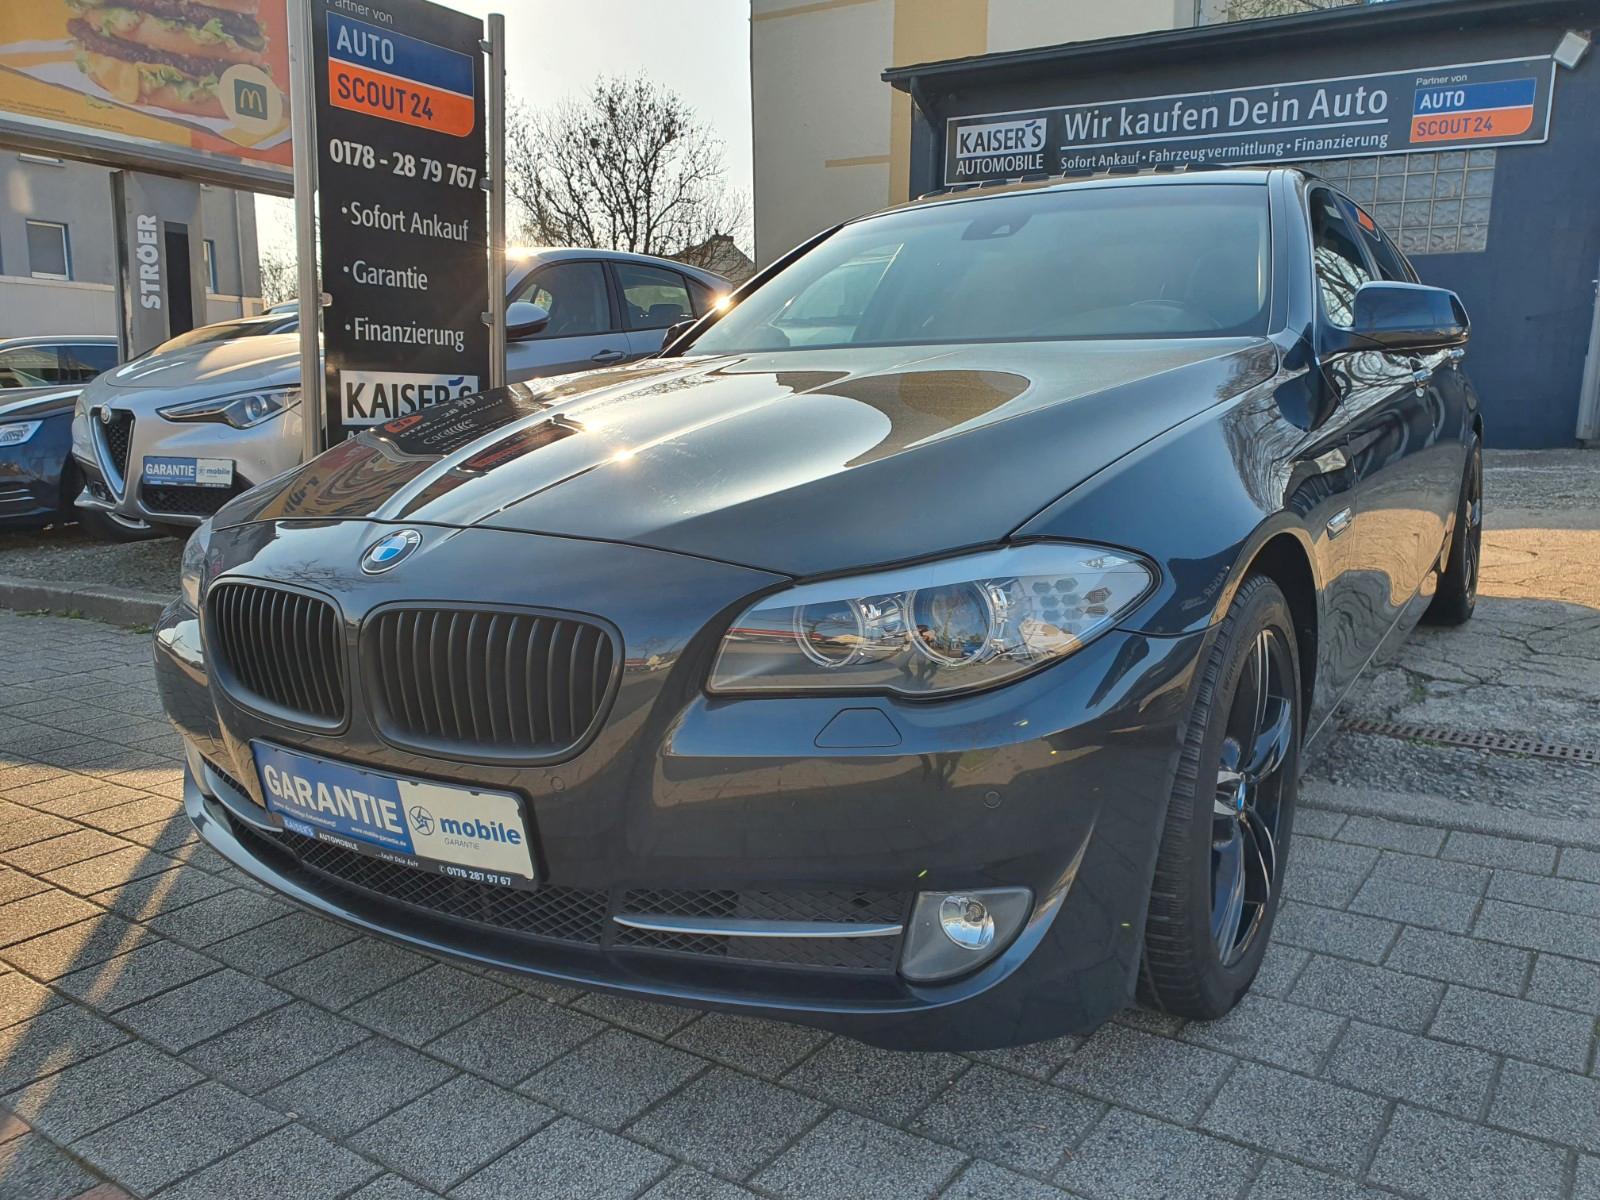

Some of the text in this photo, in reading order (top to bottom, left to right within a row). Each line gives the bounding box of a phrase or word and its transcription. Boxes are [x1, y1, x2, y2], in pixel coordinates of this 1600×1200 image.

[326, 0, 393, 24] artner von
[336, 25, 394, 65] AUTO
[1415, 74, 1467, 86] Partner von
[1064, 86, 1388, 141] Wir kaufen Dein Auto
[1419, 91, 1465, 110] AUTO
[329, 138, 376, 169] 0178
[392, 151, 416, 178] 28
[420, 157, 443, 183] 79
[446, 163, 477, 189] 767
[956, 153, 1044, 176] AUTOMOBILE
[1060, 133, 1388, 170] Sofort Ankauf Fahrzeugvermittlung Finanzierung
[350, 201, 469, 242] Sofort Ankauf
[136, 214, 161, 310] STRÖER
[352, 260, 428, 290] Garantie
[354, 317, 465, 353] Finanzierung
[145, 463, 196, 477] GARANTIE
[263, 764, 404, 834] GARANTIE
[439, 817, 522, 845] mobile
[444, 837, 481, 850] GARANTIE
[319, 832, 360, 851] AUTOMOBILE
[469, 870, 485, 882] 287
[487, 872, 498, 884] 97
[500, 874, 511, 886] 67
